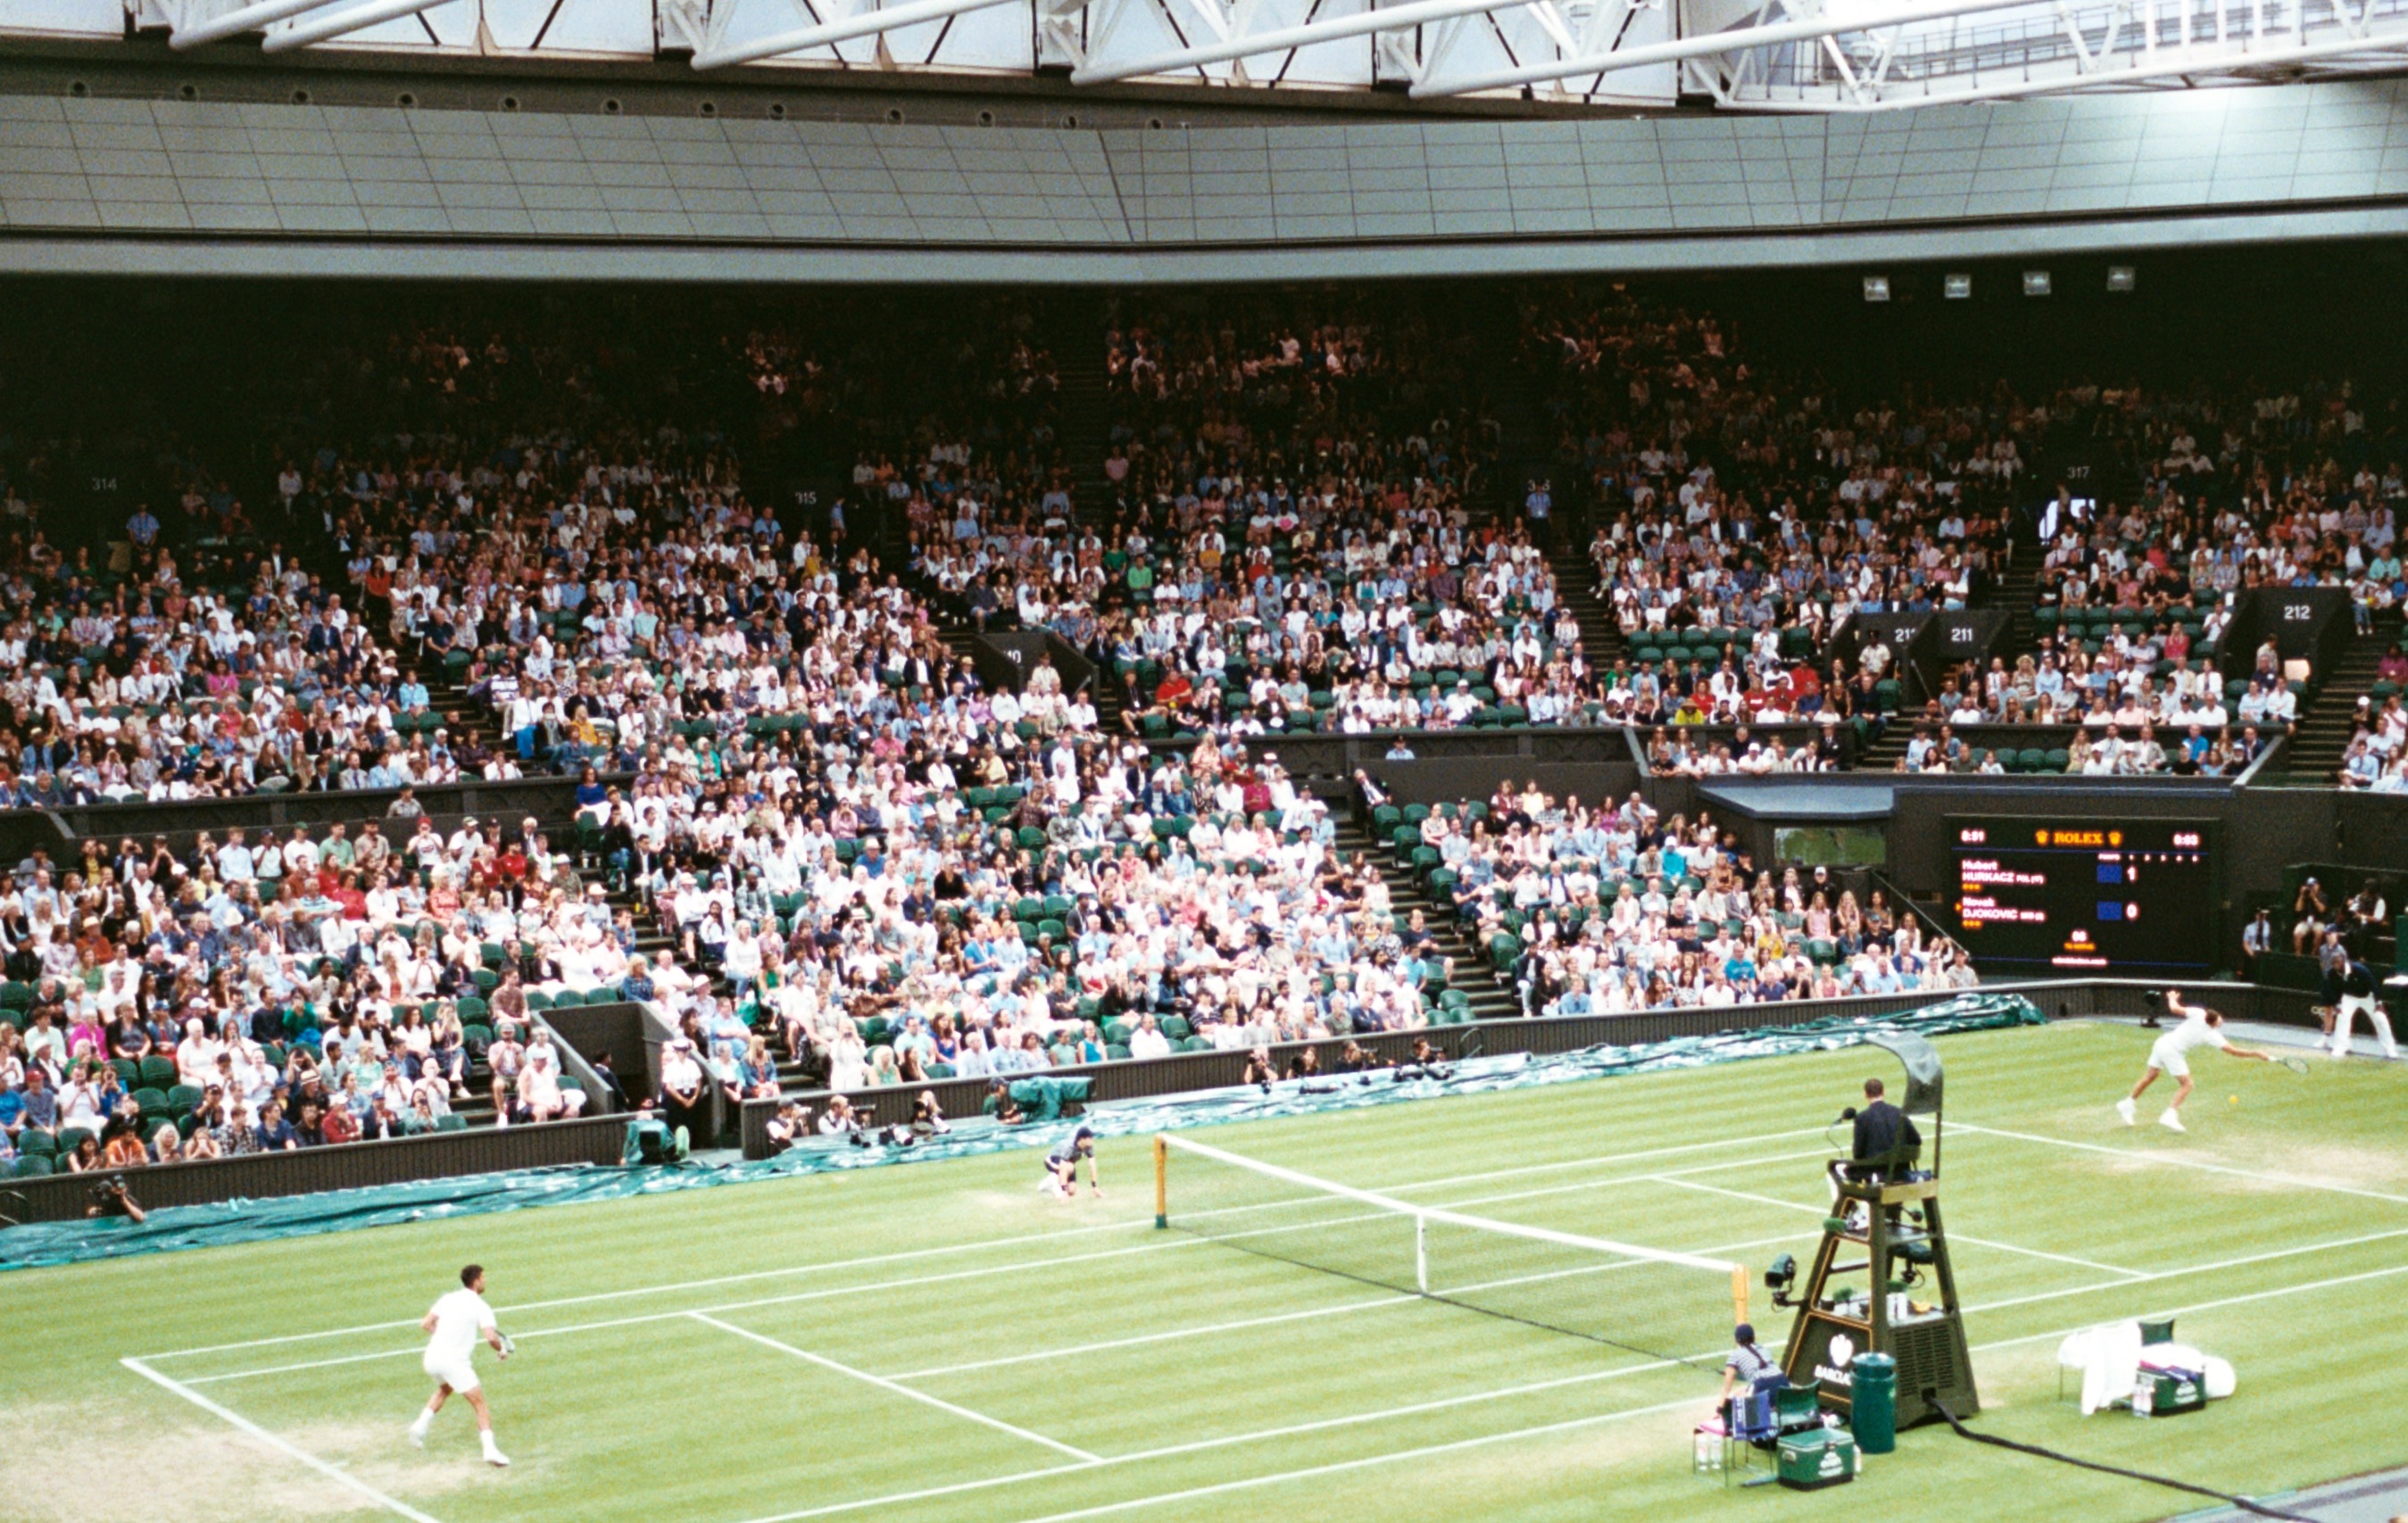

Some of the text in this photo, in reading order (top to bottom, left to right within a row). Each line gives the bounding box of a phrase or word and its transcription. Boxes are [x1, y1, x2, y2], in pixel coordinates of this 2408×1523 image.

[2067, 466, 2090, 479] 317
[92, 478, 117, 491] 314
[2284, 604, 2311, 620] 212
[1951, 628, 1973, 642] 211
[2054, 831, 2104, 845] ROLEX
[1962, 859, 1998, 871] Hubert
[1962, 871, 2015, 884] HURKACZ
[2127, 865, 2137, 882] 1
[1963, 895, 1996, 908] Novak
[1963, 908, 2019, 920] DJOKOVIC
[2125, 903, 2138, 920] 0
[1814, 1363, 1852, 1386] BARCLA
